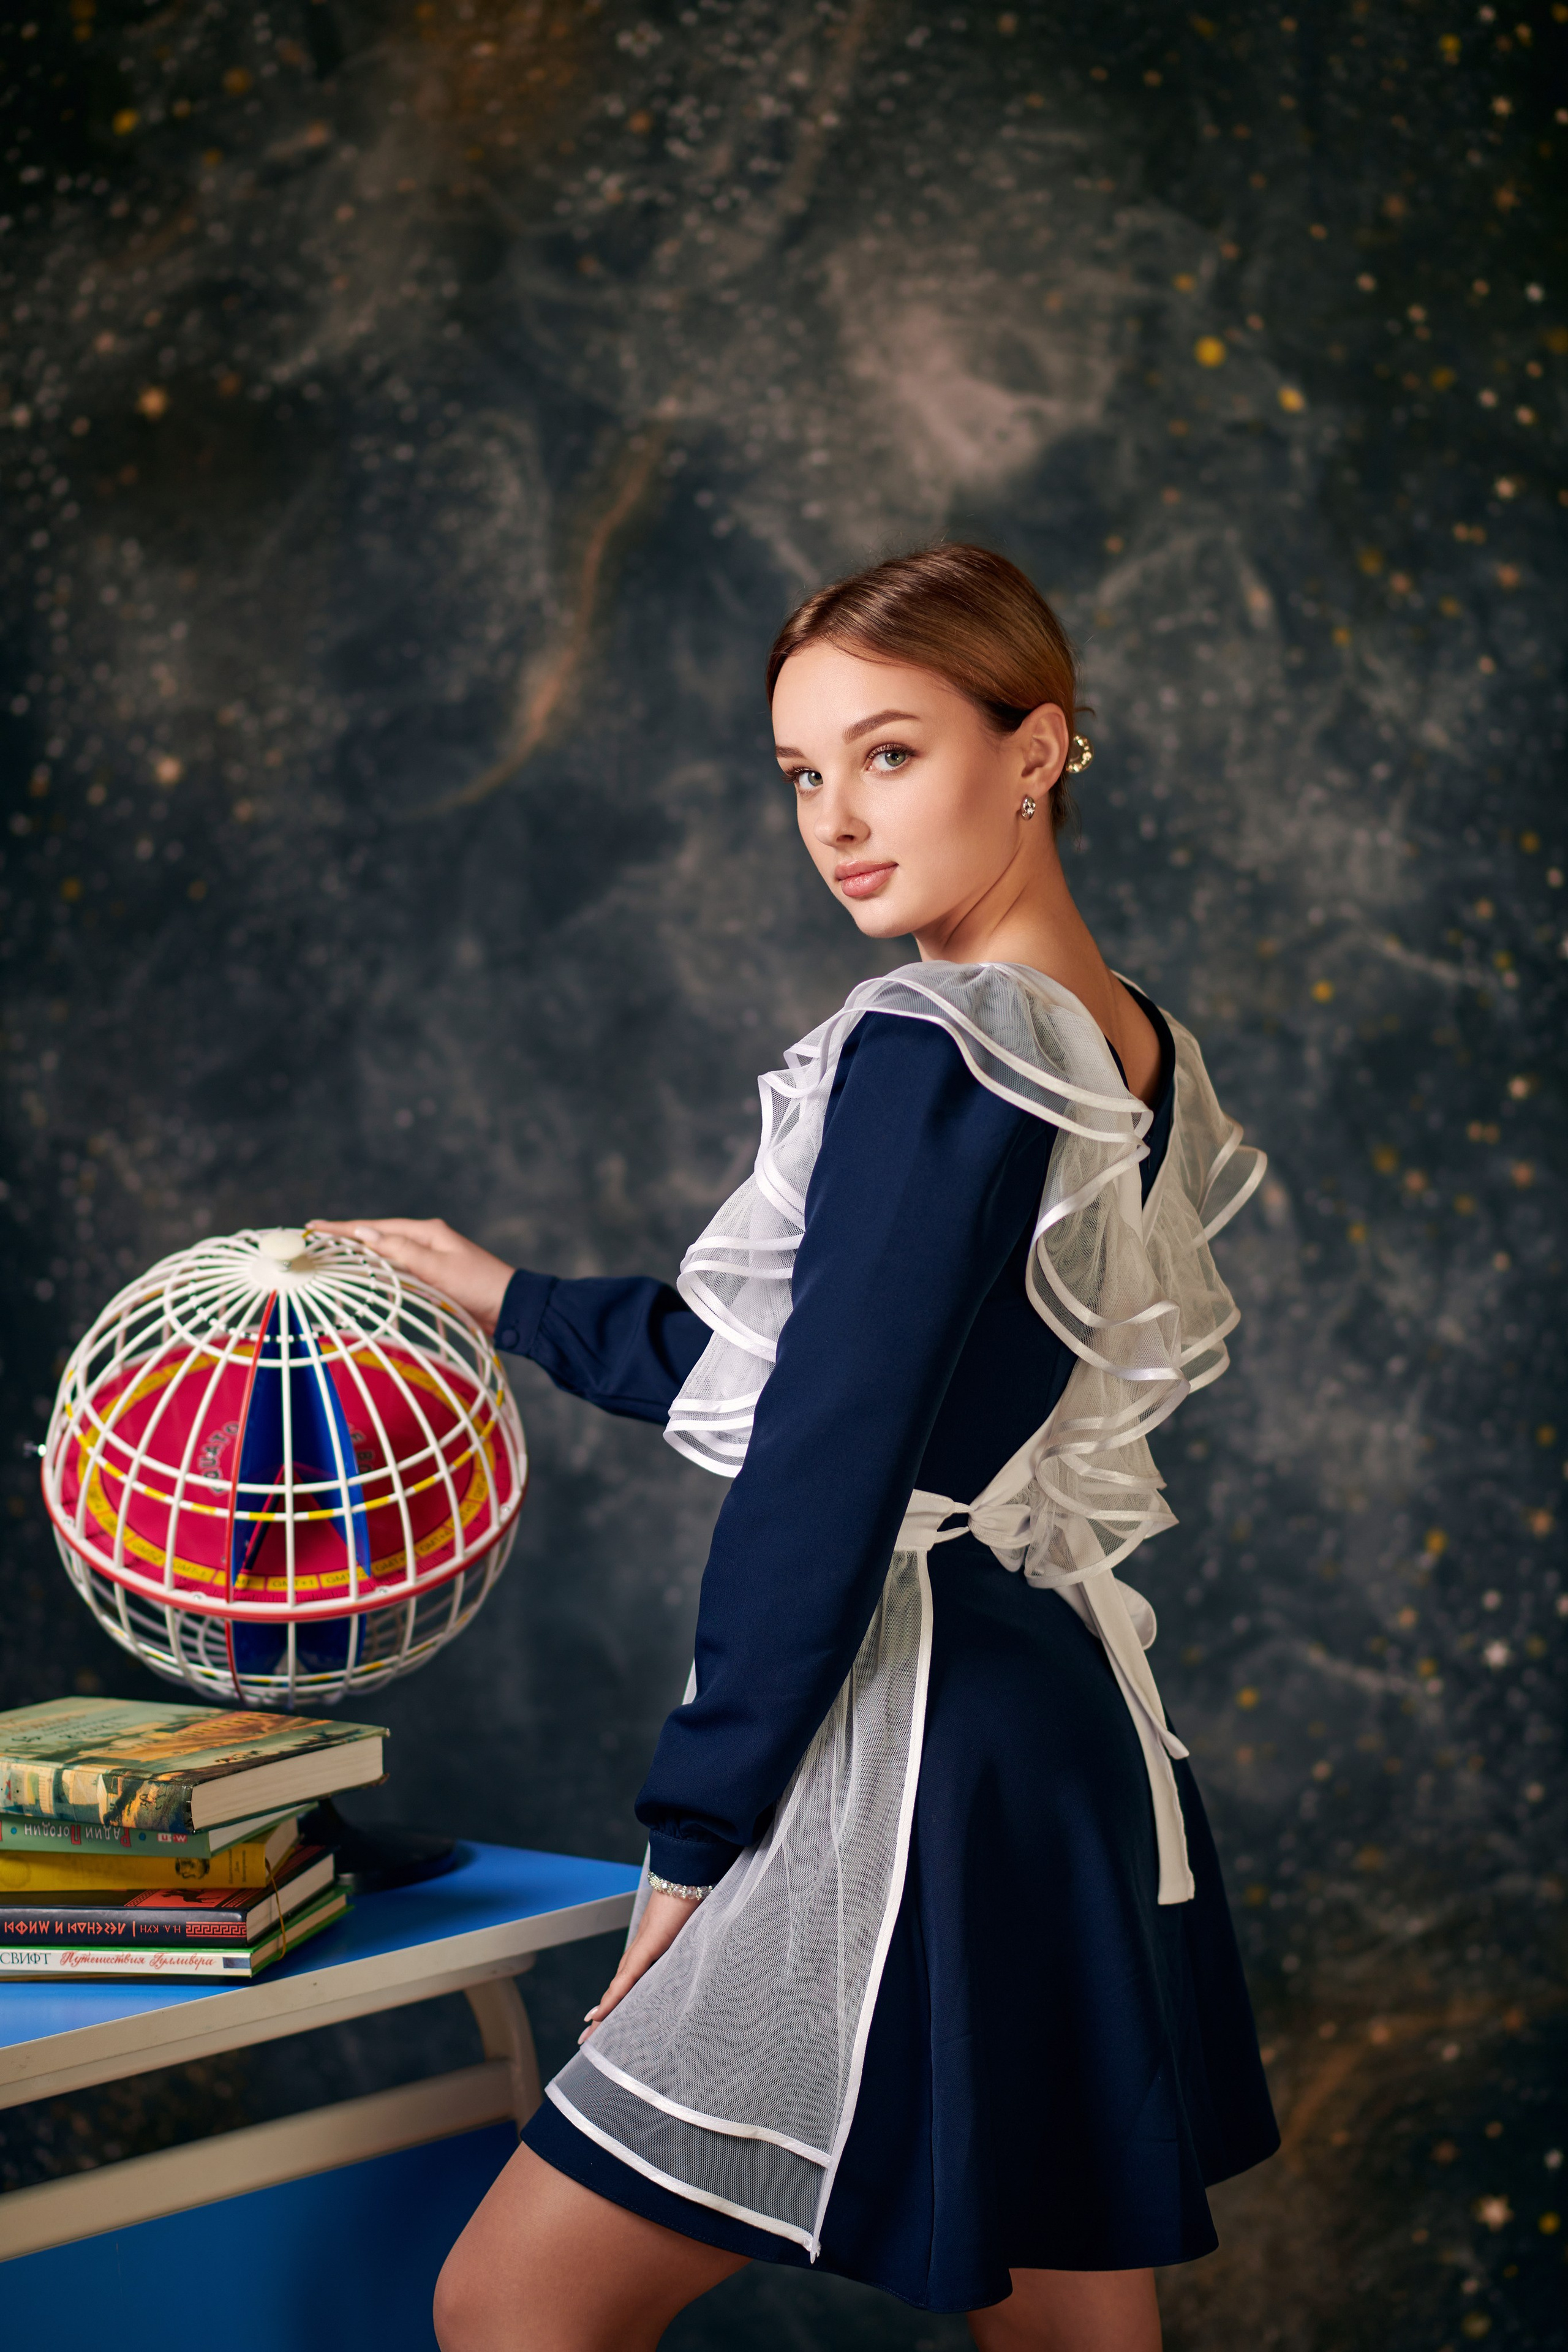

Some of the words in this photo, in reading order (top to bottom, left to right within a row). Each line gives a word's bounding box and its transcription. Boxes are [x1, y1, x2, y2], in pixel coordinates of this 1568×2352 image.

[4, 1920, 50, 1935] МИФЫ
[55, 1921, 63, 1934] И
[140, 1924, 159, 1933] КУН
[0, 1951, 51, 1965] СВИФТ
[59, 1951, 145, 1968] Путешествия
[149, 1952, 214, 1970] Гулливера
